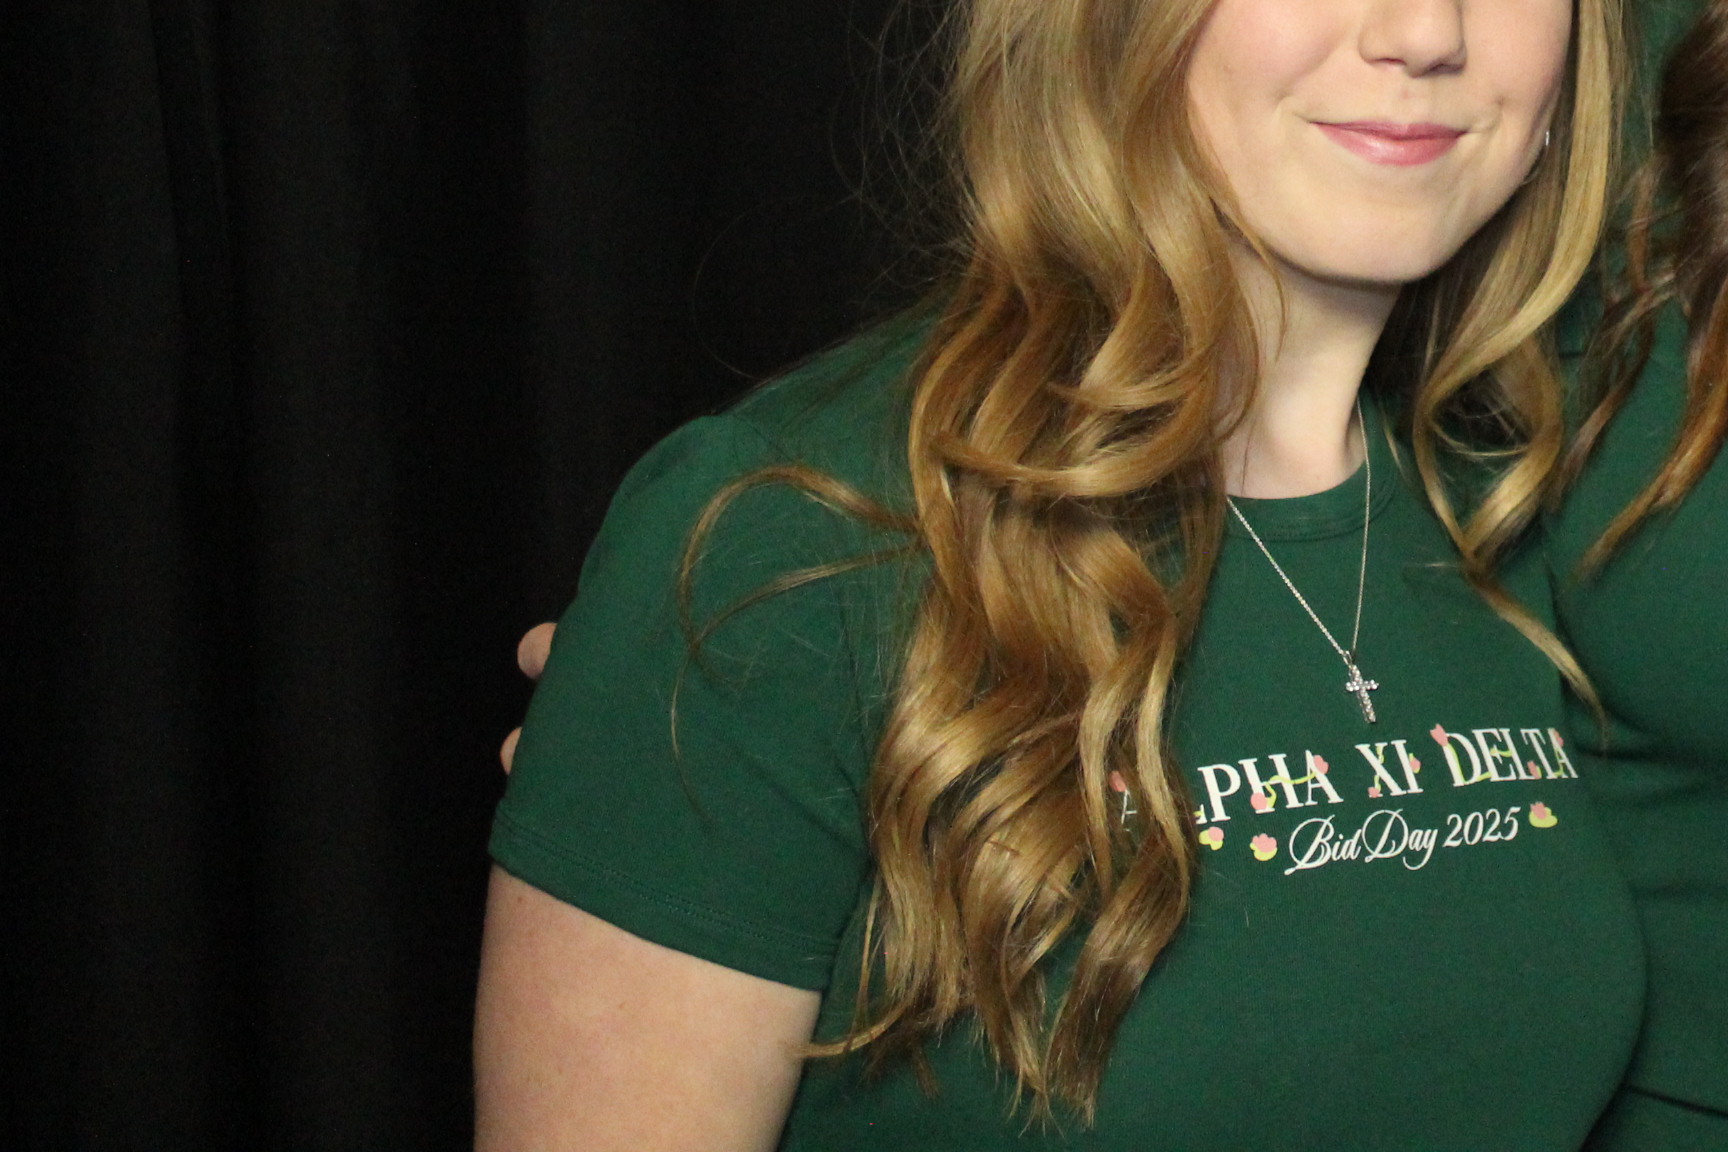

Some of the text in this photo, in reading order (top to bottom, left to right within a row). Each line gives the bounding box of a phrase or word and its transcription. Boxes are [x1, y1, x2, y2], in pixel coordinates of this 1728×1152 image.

[1355, 739, 1424, 798] XI
[1440, 727, 1579, 788] DELTA
[1284, 806, 1521, 876] Bid Day 2025
